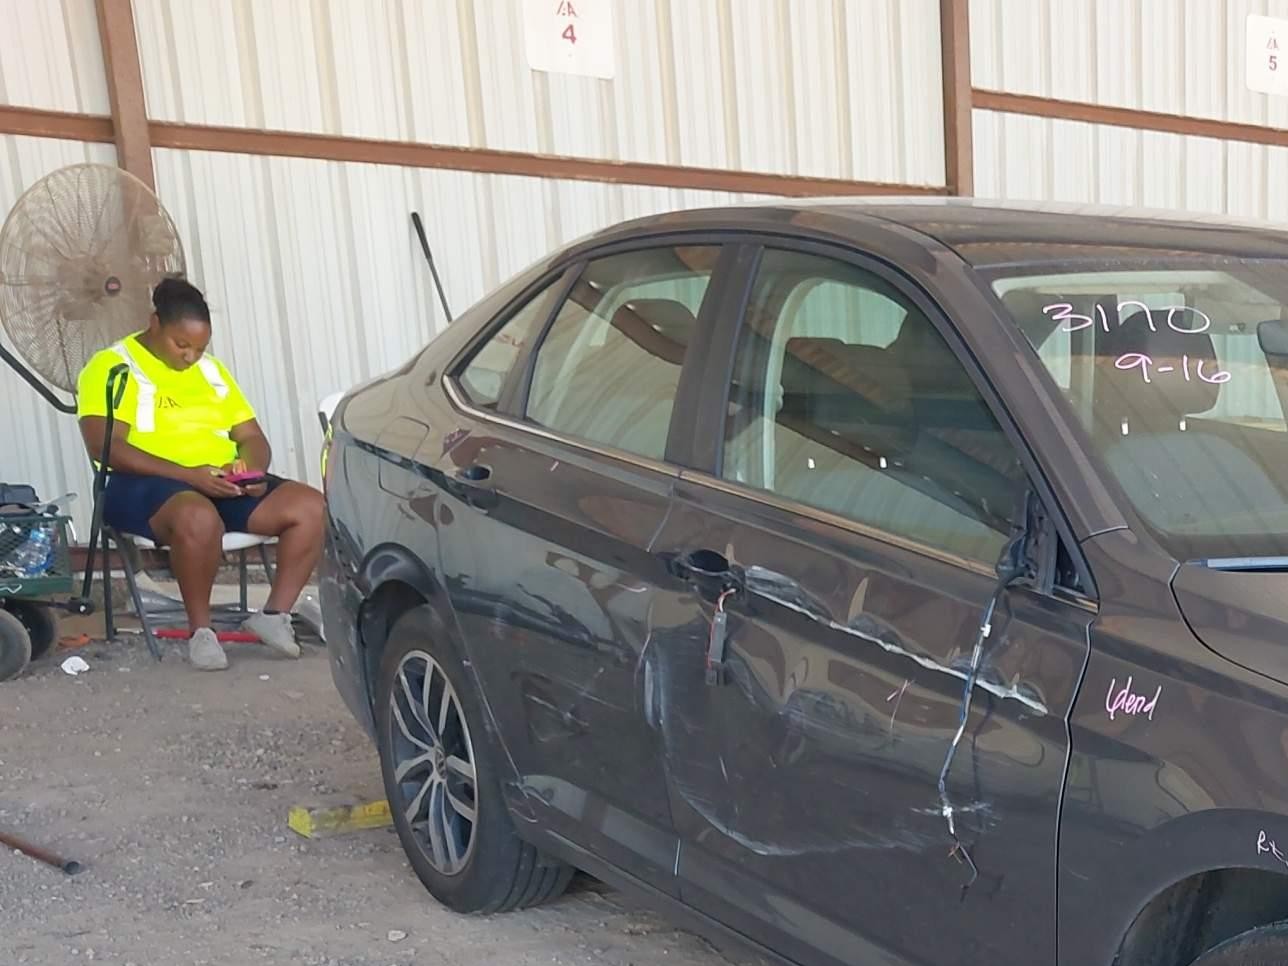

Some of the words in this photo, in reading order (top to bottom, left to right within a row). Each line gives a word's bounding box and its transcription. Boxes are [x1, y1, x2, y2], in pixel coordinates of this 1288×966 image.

[562, 24, 577, 45] 4
[1268, 55, 1278, 71] 5
[1043, 301, 1210, 333] 3170
[1114, 353, 1231, 383] 9-16
